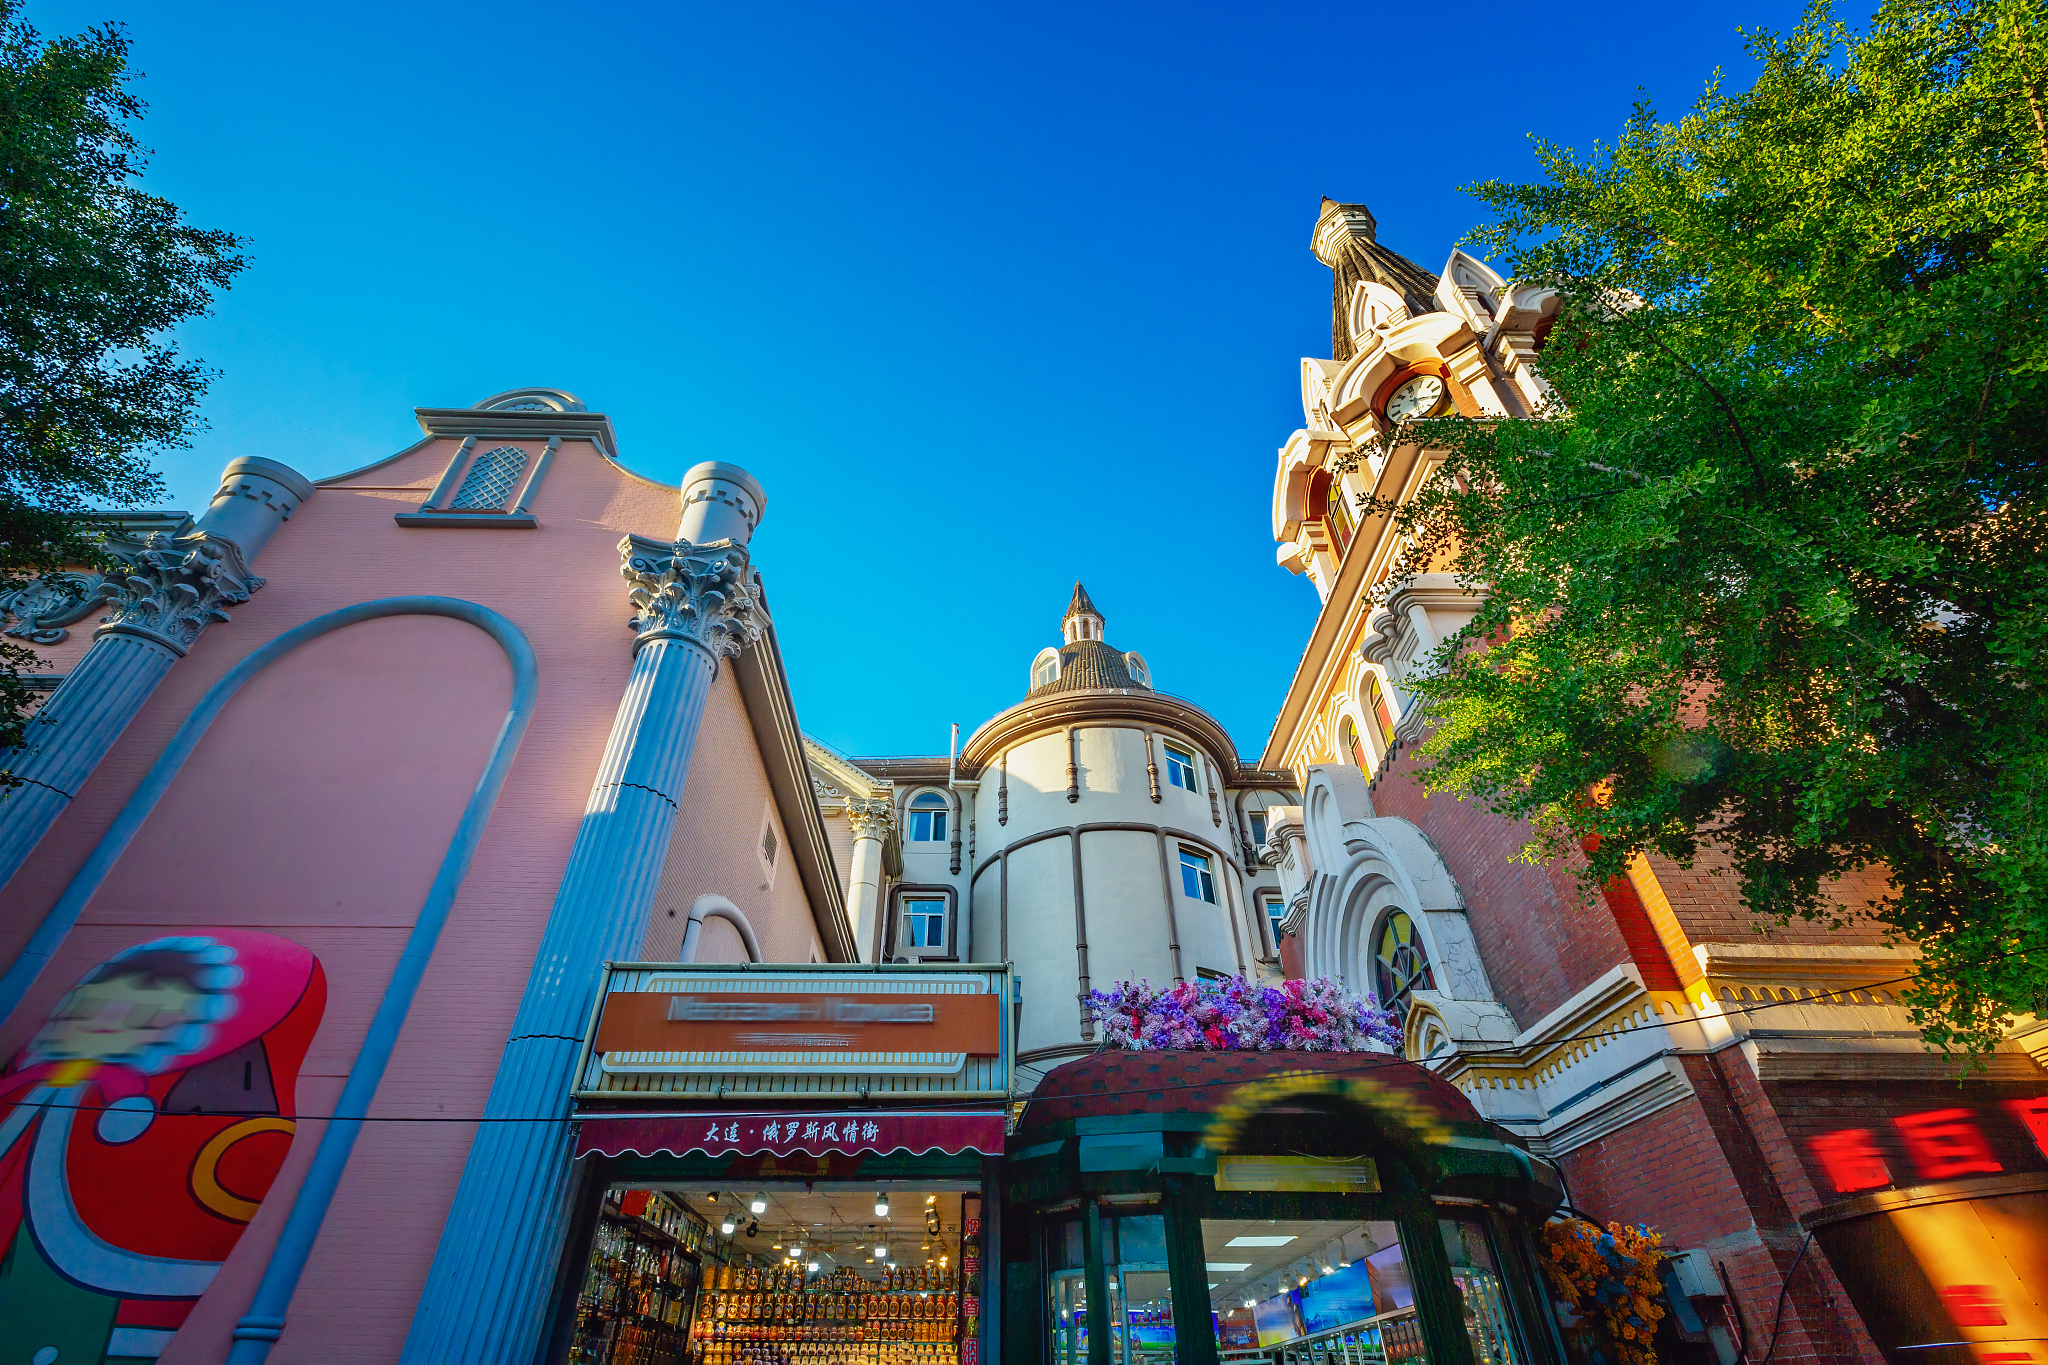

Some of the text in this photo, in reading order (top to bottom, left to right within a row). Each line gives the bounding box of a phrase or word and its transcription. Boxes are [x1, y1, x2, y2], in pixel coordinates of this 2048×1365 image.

[703, 1119, 880, 1144] 大连·俄罗斯风情街
